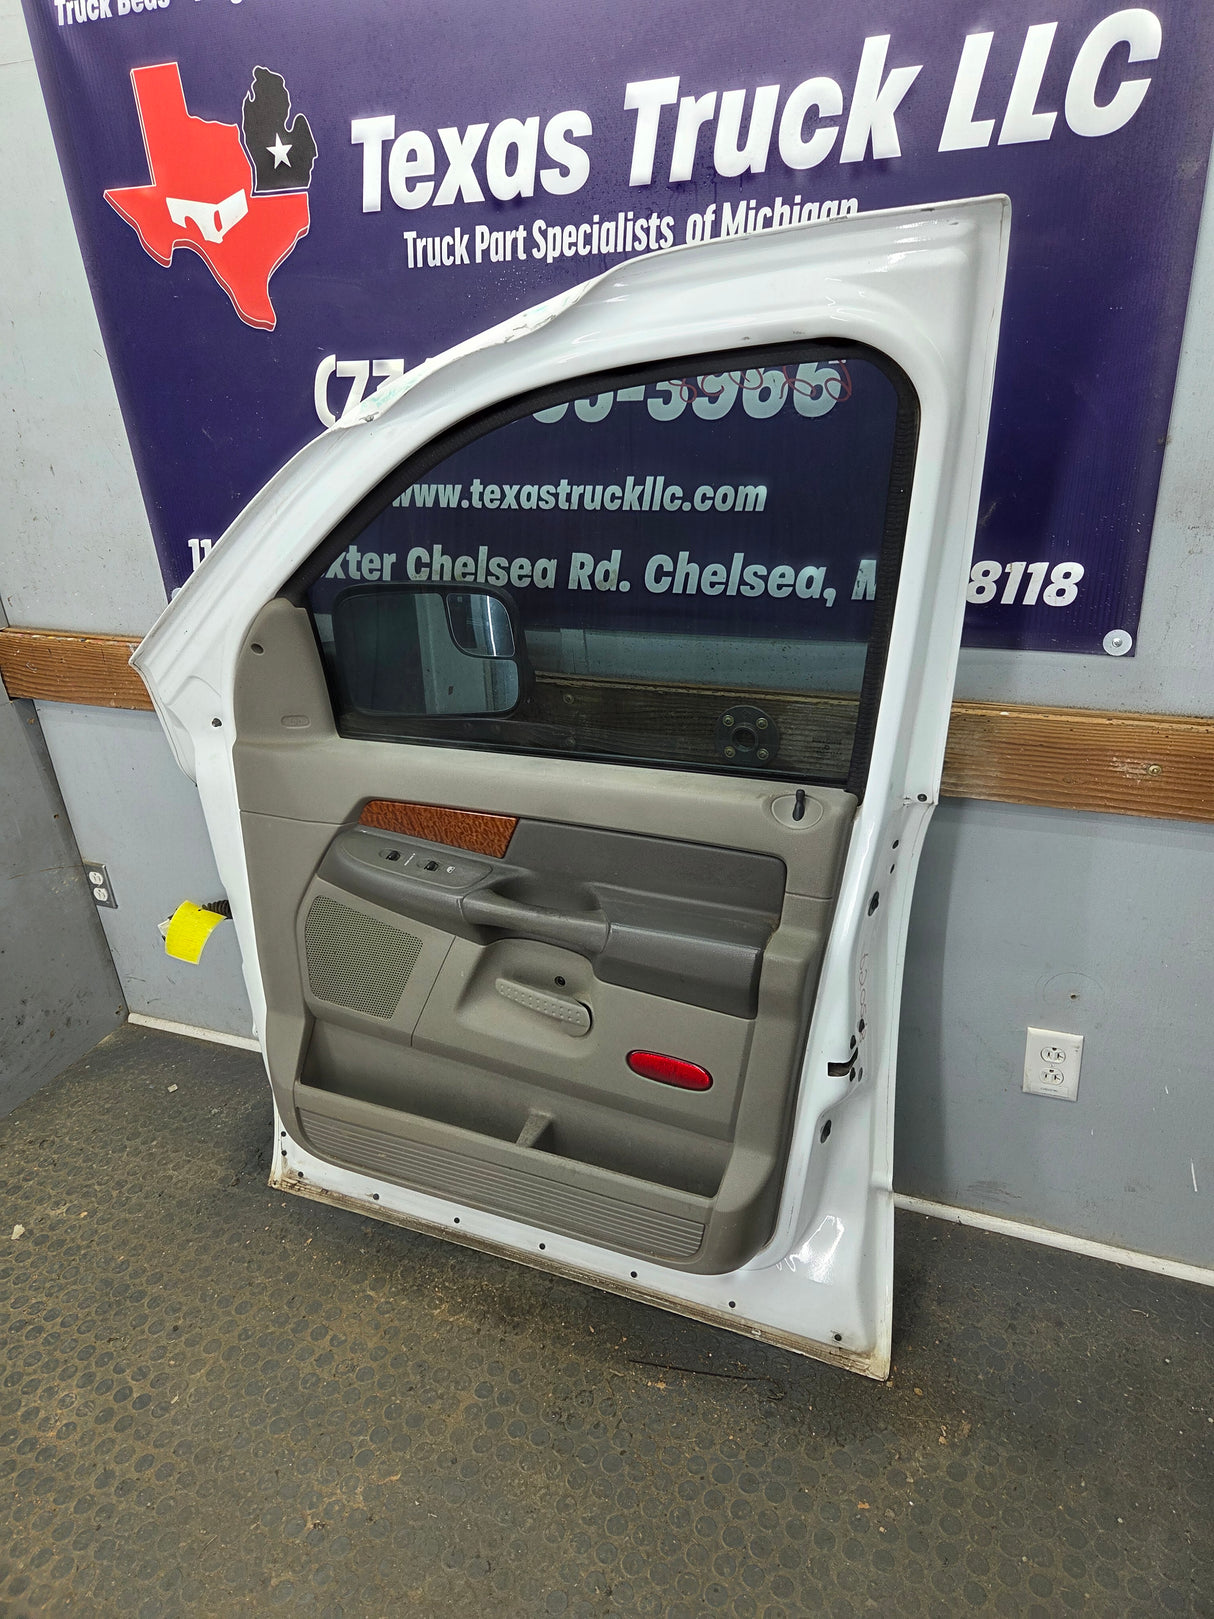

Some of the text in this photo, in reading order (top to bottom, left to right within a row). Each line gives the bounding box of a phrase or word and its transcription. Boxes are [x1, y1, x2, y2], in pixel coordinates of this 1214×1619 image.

[55, 0, 112, 26] Truck
[350, 8, 1162, 213] Texas Truck LLC
[403, 227, 470, 269] Truck
[475, 224, 527, 264] Part
[532, 211, 675, 263] Specialists
[686, 204, 716, 245] of
[392, 476, 768, 512] www.texastruckllc.com
[321, 545, 396, 581] xter
[406, 544, 557, 588] Chelsea
[568, 550, 631, 592] Rd.
[644, 551, 836, 607] Chelsea,
